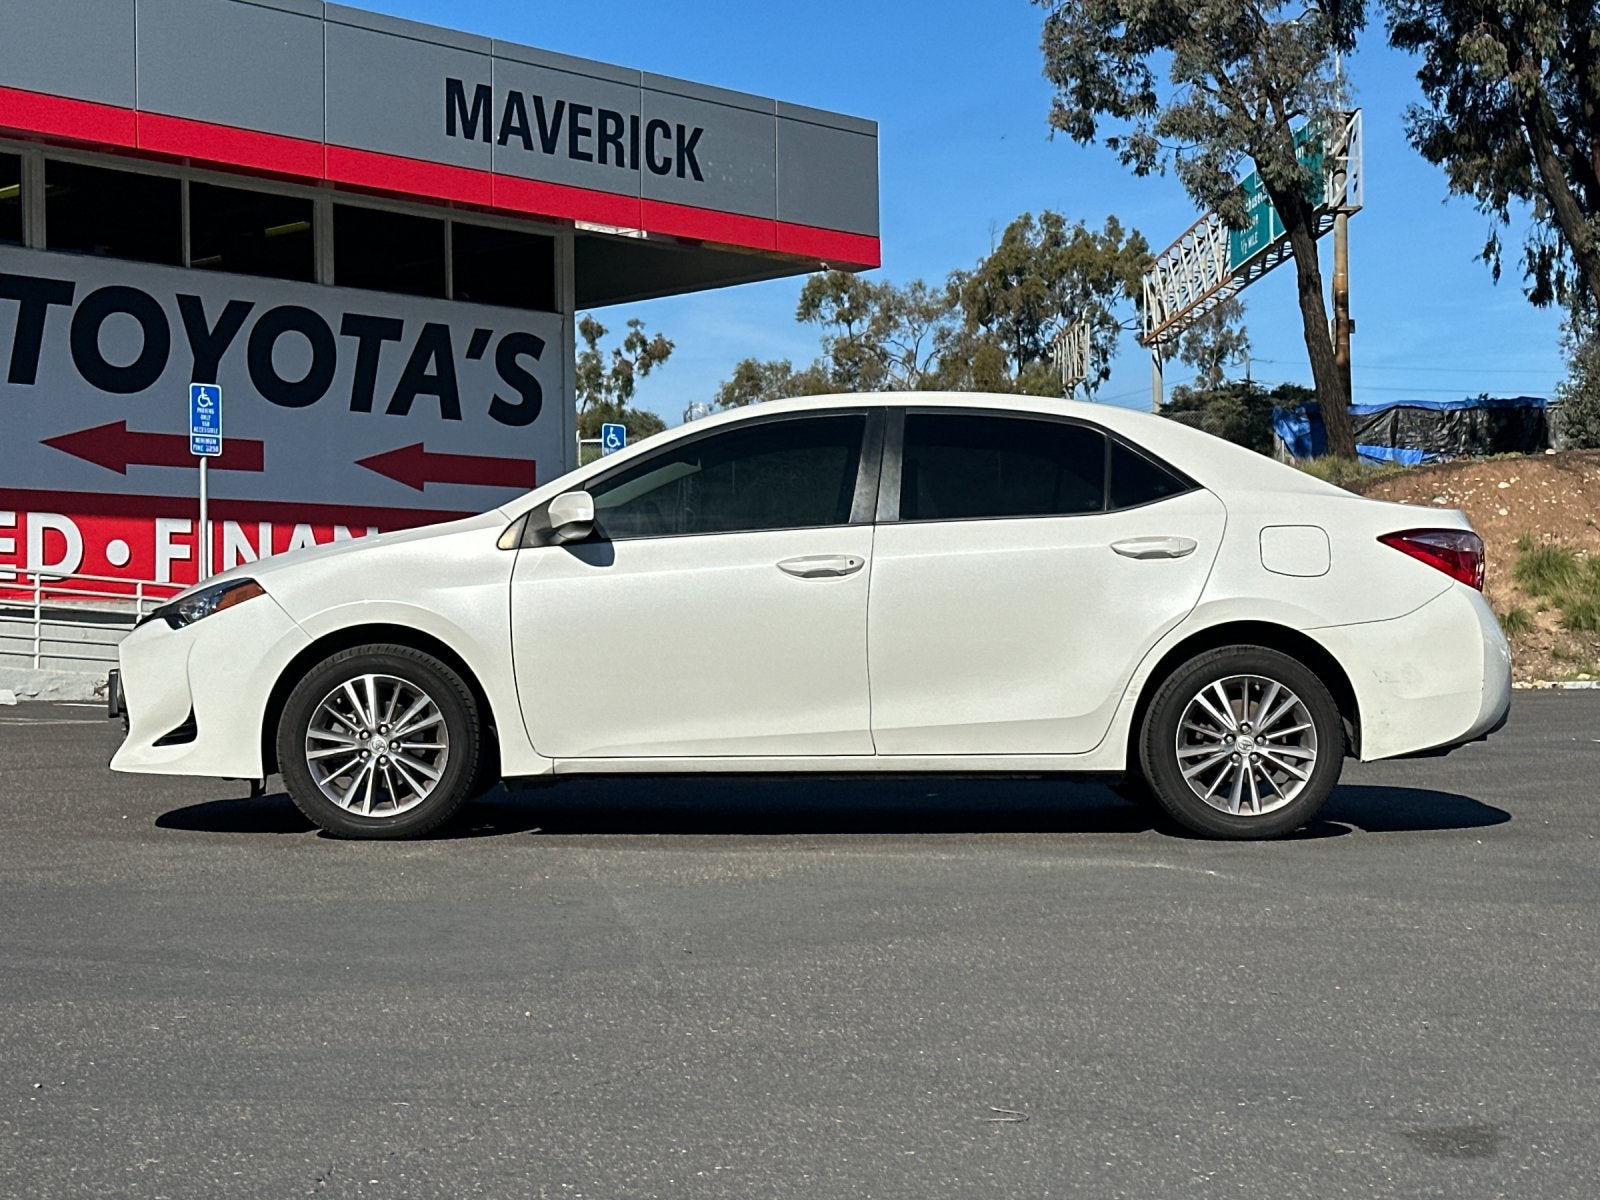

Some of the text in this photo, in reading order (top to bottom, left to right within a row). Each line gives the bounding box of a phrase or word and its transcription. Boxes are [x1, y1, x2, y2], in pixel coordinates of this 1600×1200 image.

[446, 78, 705, 182] MAVERICK
[0, 273, 545, 427] TOYOTA'S
[154, 517, 380, 583] FIN
